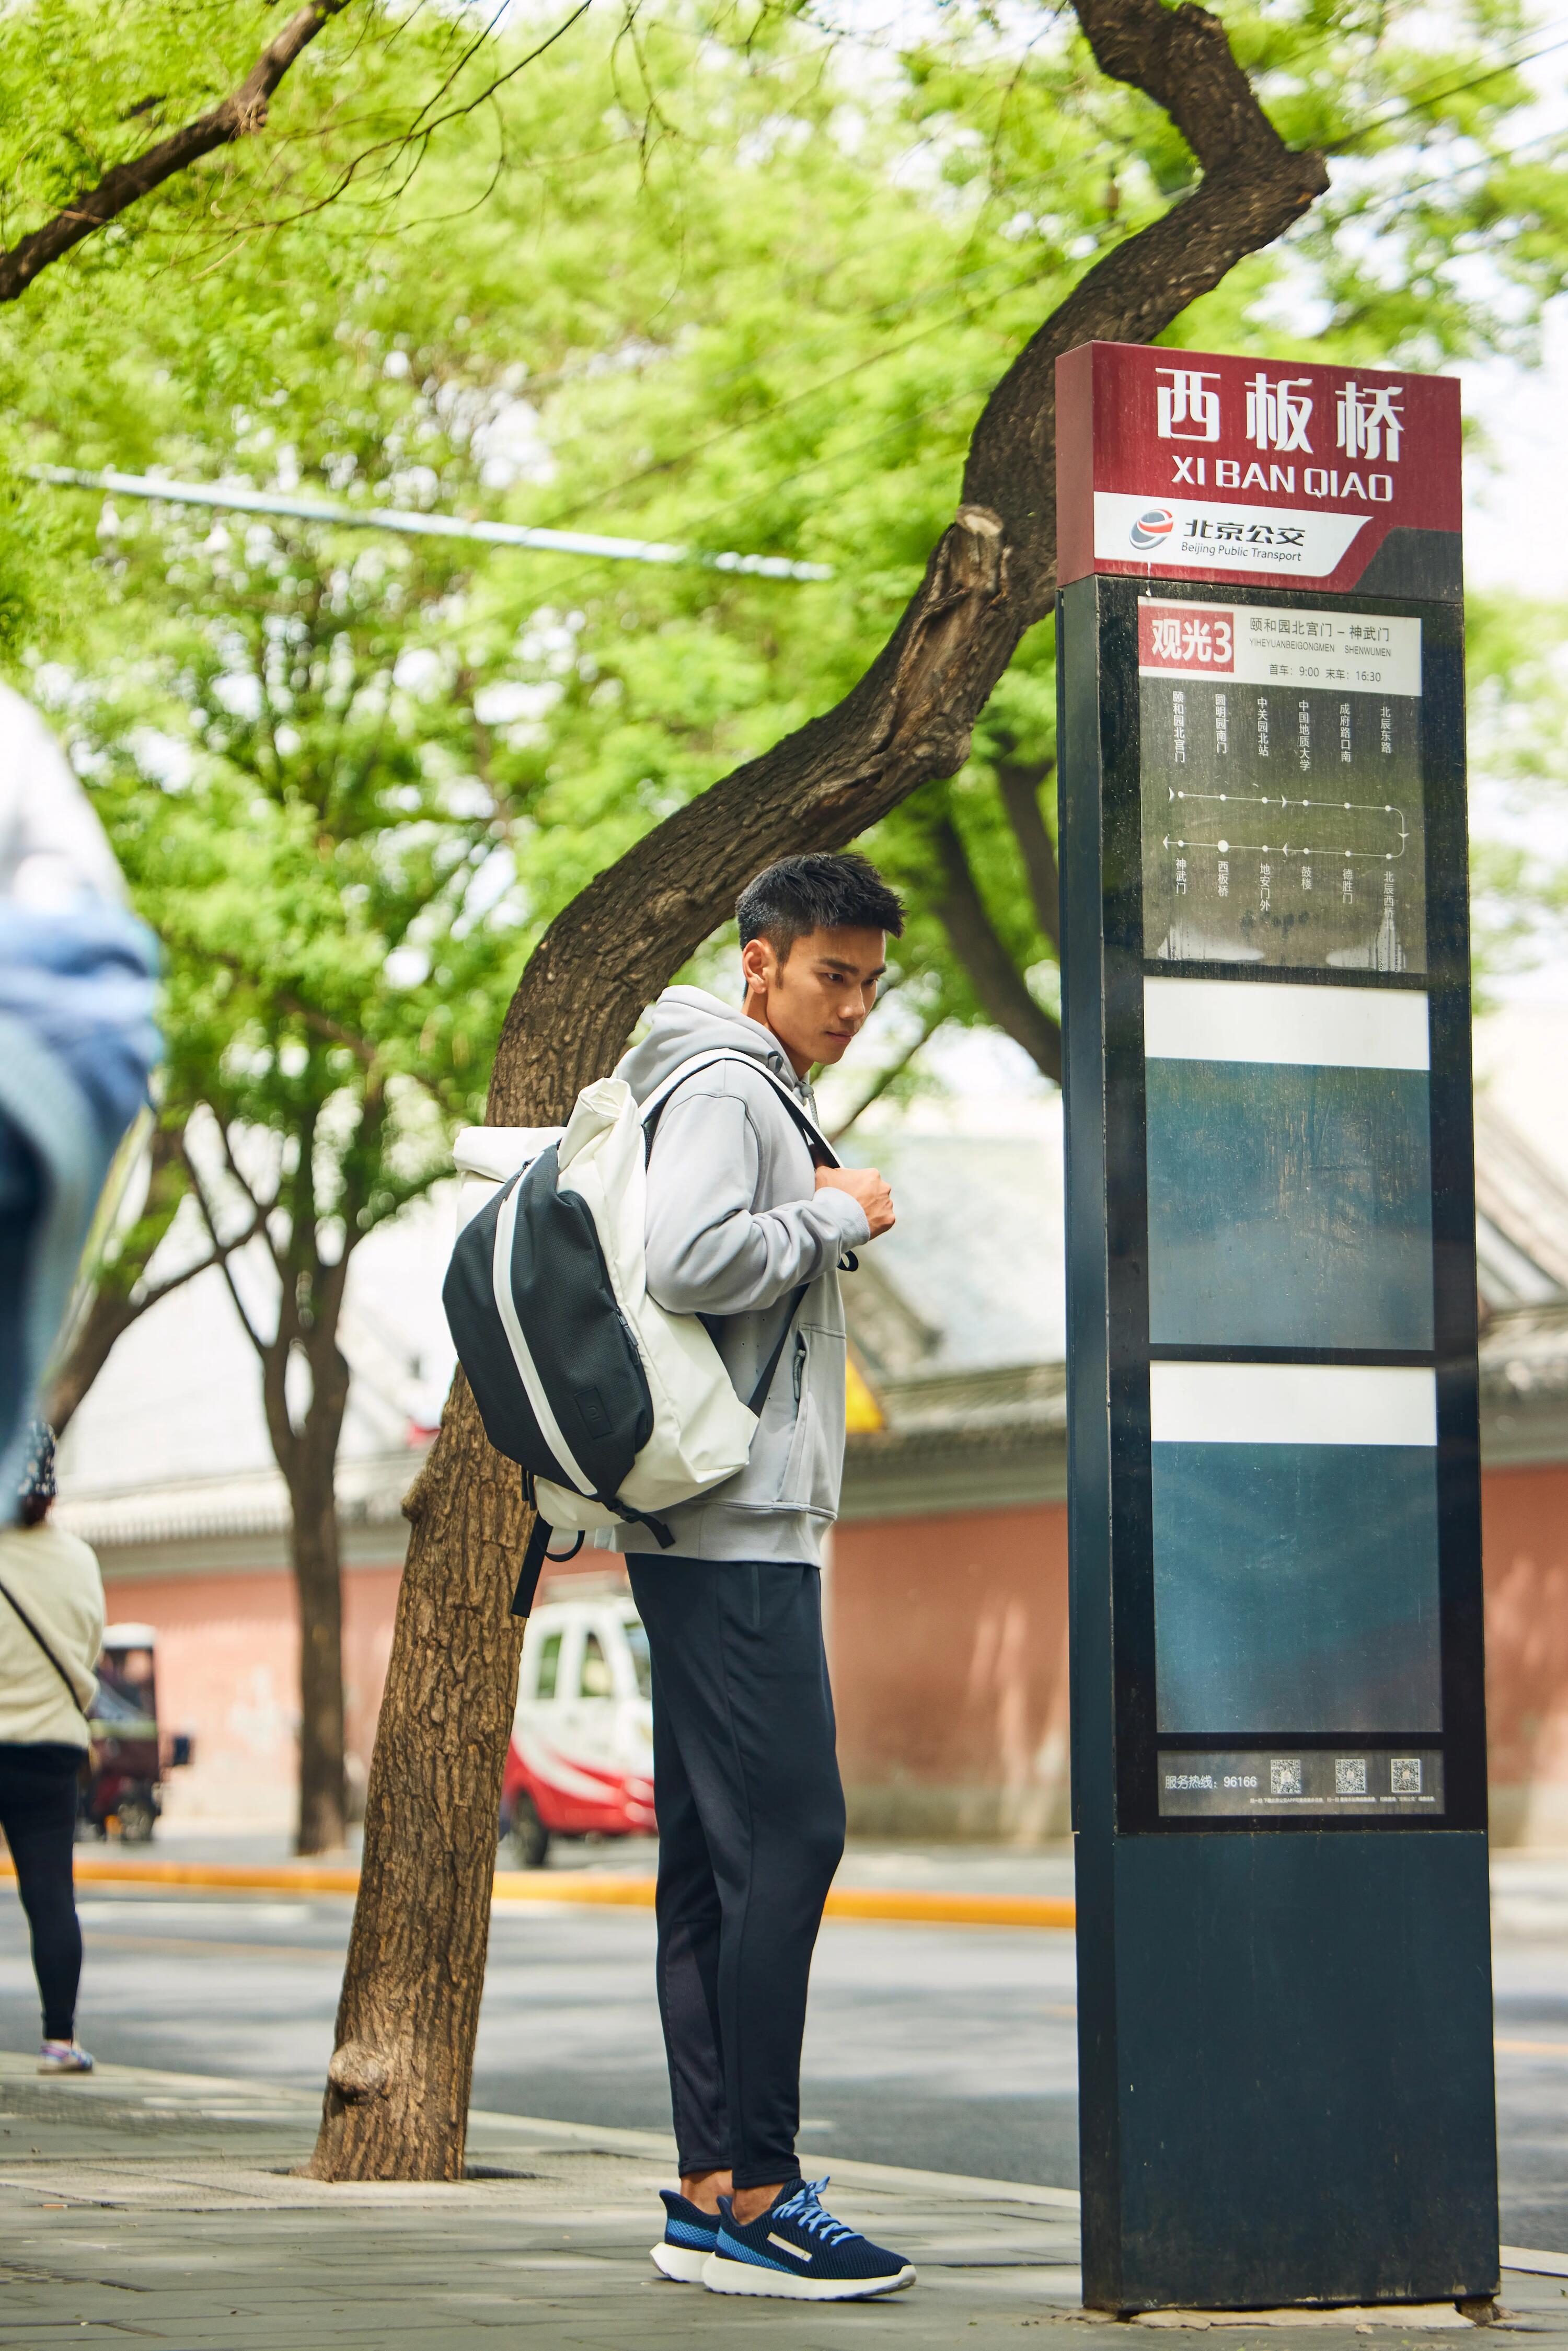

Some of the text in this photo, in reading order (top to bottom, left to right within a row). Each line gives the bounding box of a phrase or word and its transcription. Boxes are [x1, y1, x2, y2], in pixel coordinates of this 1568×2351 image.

[1155, 367, 1404, 462] 西板桥
[1171, 455, 1392, 502] XI BAN QIAO
[1181, 541, 1301, 562] Beijing Public Transport
[1183, 518, 1305, 547] 北京公交
[1151, 618, 1232, 663] 观光3
[1250, 638, 1391, 657] YIHEYUANBEIGONGMEN SHENWUMEN
[1173, 690, 1185, 763] 颐和园北宫门
[1215, 694, 1227, 754] 圆明园南门
[1257, 696, 1269, 757] 中关园北站
[1299, 700, 1310, 771] 中国地质大学
[1340, 703, 1351, 763] 成府路口南
[1380, 706, 1392, 754] 北辰东路
[1175, 858, 1187, 895] 神武门
[1217, 861, 1229, 897] 西板桥
[1260, 863, 1271, 912] 地安门外
[1301, 866, 1312, 890] 鼓楼
[1342, 868, 1354, 905] 德胜门
